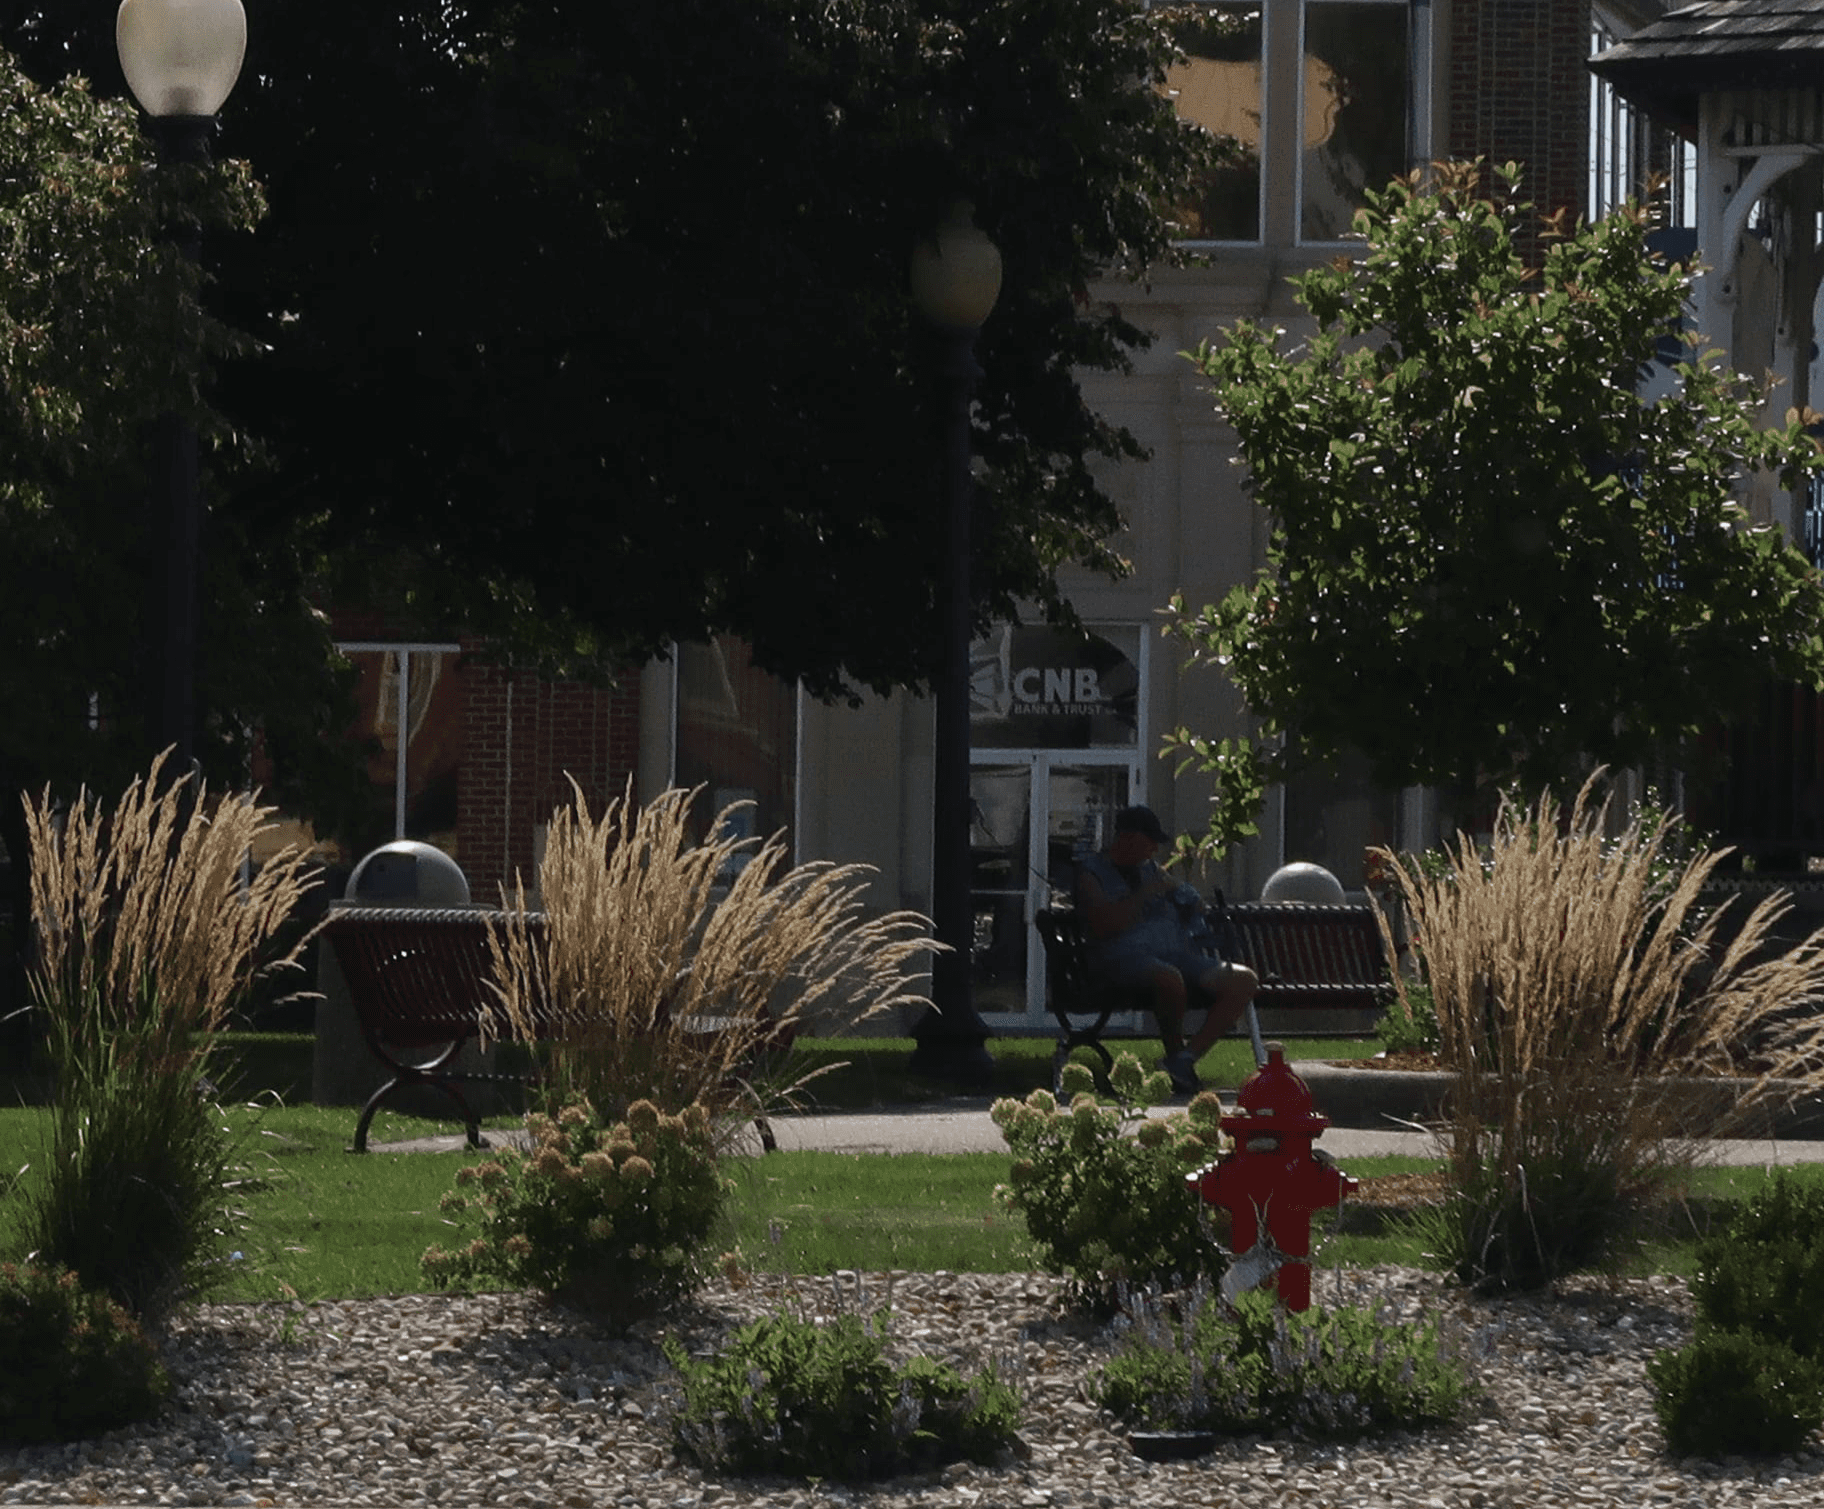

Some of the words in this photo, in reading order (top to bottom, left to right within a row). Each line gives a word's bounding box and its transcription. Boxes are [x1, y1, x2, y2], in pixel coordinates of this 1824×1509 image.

[1013, 666, 1101, 703] CNB
[1014, 703, 1049, 715] BANK
[1052, 703, 1061, 715] &
[1064, 703, 1101, 715] TRUST
